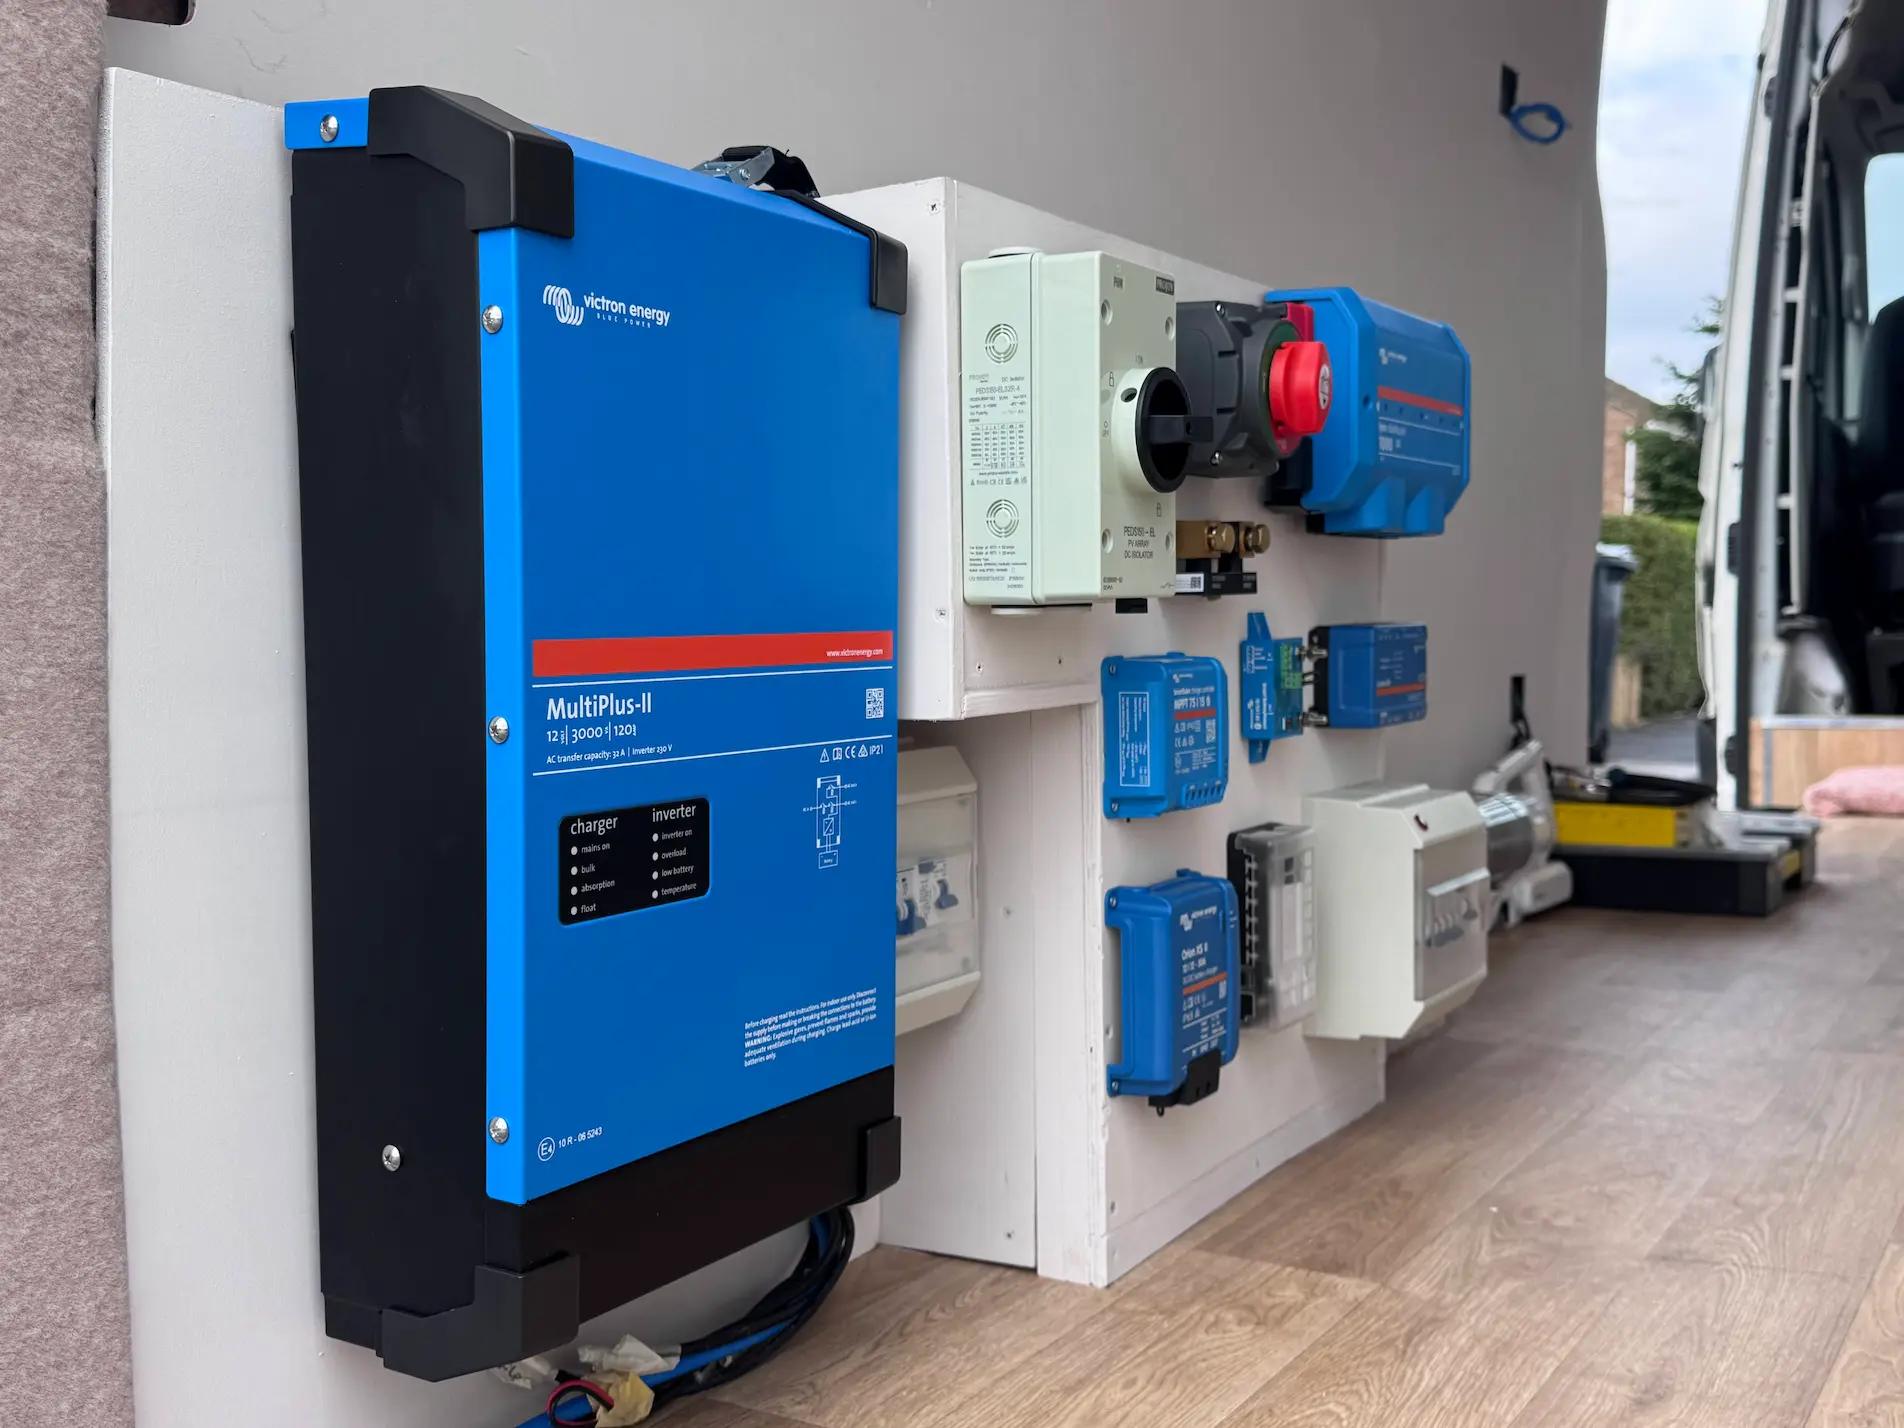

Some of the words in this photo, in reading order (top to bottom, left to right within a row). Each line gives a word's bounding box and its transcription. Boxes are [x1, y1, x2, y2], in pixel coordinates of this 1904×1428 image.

[583, 292, 626, 315] victron
[629, 304, 670, 326] energy
[624, 318, 651, 328] POWER
[826, 648, 884, 658] www.victronenergy.com
[547, 692, 652, 720] MultiPlus-II
[547, 730, 559, 742] 12
[572, 726, 603, 744] 3000
[613, 724, 632, 737] 120
[547, 755, 556, 764] AC
[557, 752, 583, 763] transfer
[584, 750, 612, 762] capacity:
[620, 748, 626, 757] A
[632, 746, 656, 755] Inverter
[656, 745, 667, 754] 230
[667, 743, 673, 752] V
[869, 744, 884, 756] IP21
[652, 804, 696, 823] inverter
[570, 816, 618, 836] charger
[661, 830, 684, 840] inverter
[685, 828, 693, 837] on
[581, 844, 600, 854] mains
[601, 842, 610, 850] on
[661, 847, 687, 859] overload
[581, 863, 596, 874] bulk
[661, 869, 672, 877] low
[673, 864, 694, 876] battery
[581, 880, 615, 893] absorption
[661, 882, 697, 896] temperature
[581, 903, 597, 914] float
[745, 1021, 759, 1030] Before
[760, 1016, 778, 1026] charging
[779, 1012, 788, 1020] read
[753, 1027, 767, 1037] supply
[768, 1023, 781, 1032] before
[782, 1019, 797, 1028] making
[803, 1012, 820, 1022] breaking
[745, 1034, 772, 1048] WARNING:
[773, 1029, 793, 1040] Explosive
[745, 1046, 766, 1058] adequate
[767, 1038, 791, 1051] ventilation
[792, 1034, 806, 1043] during
[744, 1055, 765, 1067] batteries
[558, 1138, 566, 1149] 10
[567, 1135, 573, 1146] R
